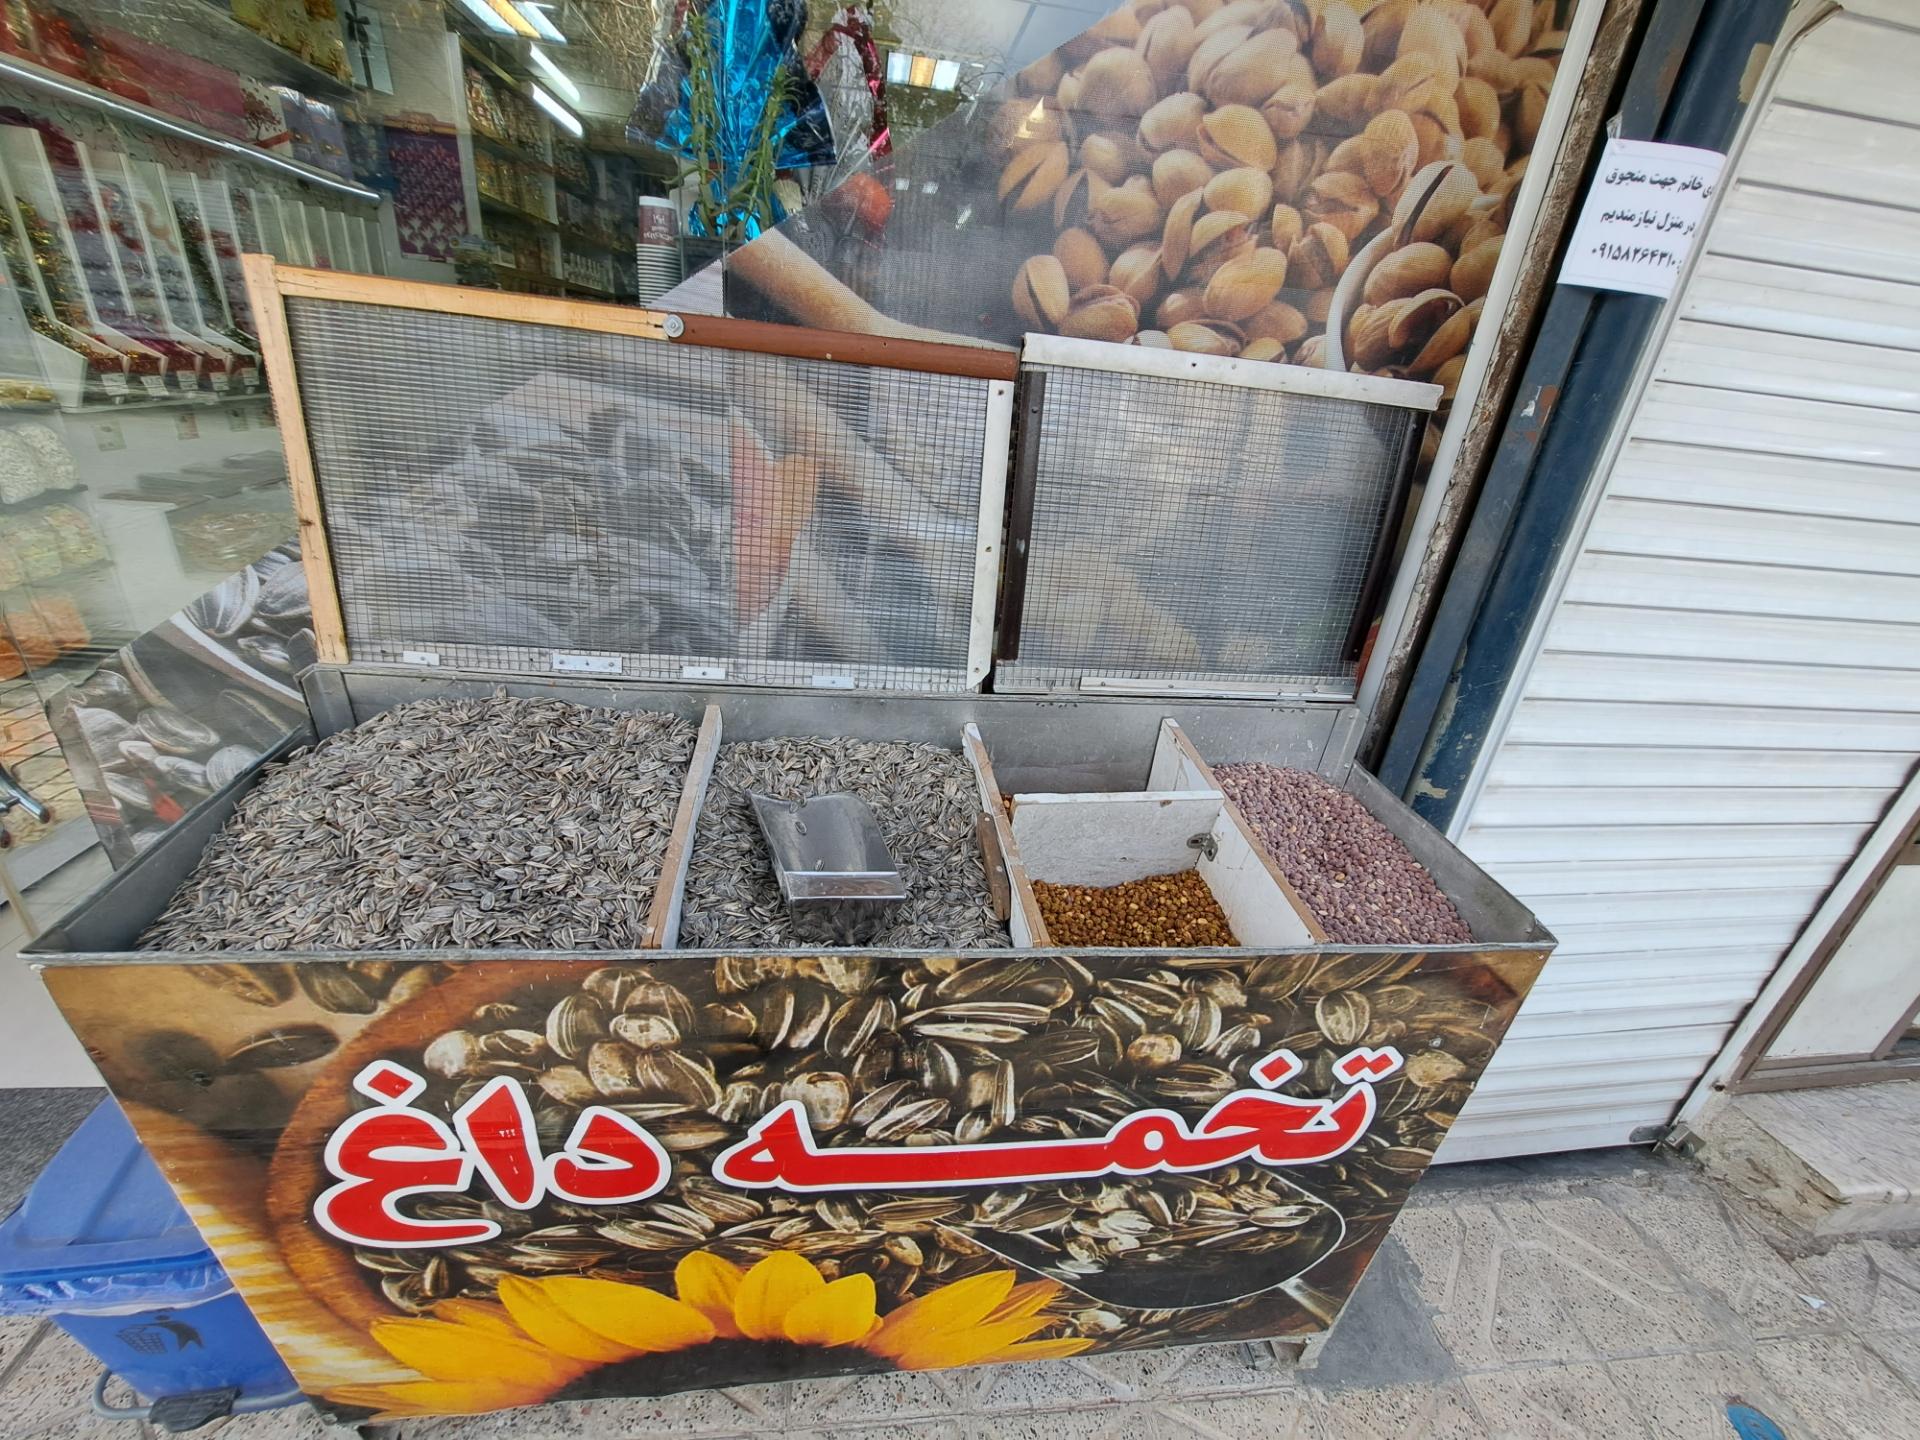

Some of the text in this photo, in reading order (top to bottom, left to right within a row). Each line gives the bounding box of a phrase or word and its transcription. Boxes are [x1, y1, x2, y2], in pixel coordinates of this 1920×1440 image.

[1605, 167, 1646, 186] منجوق
[1649, 173, 1678, 191] جهت
[1677, 173, 1703, 193] خانم
[1600, 208, 1657, 229] نیازمندیم
[1656, 212, 1684, 232] منزل
[313, 1046, 1405, 1250] تخمه داغ
